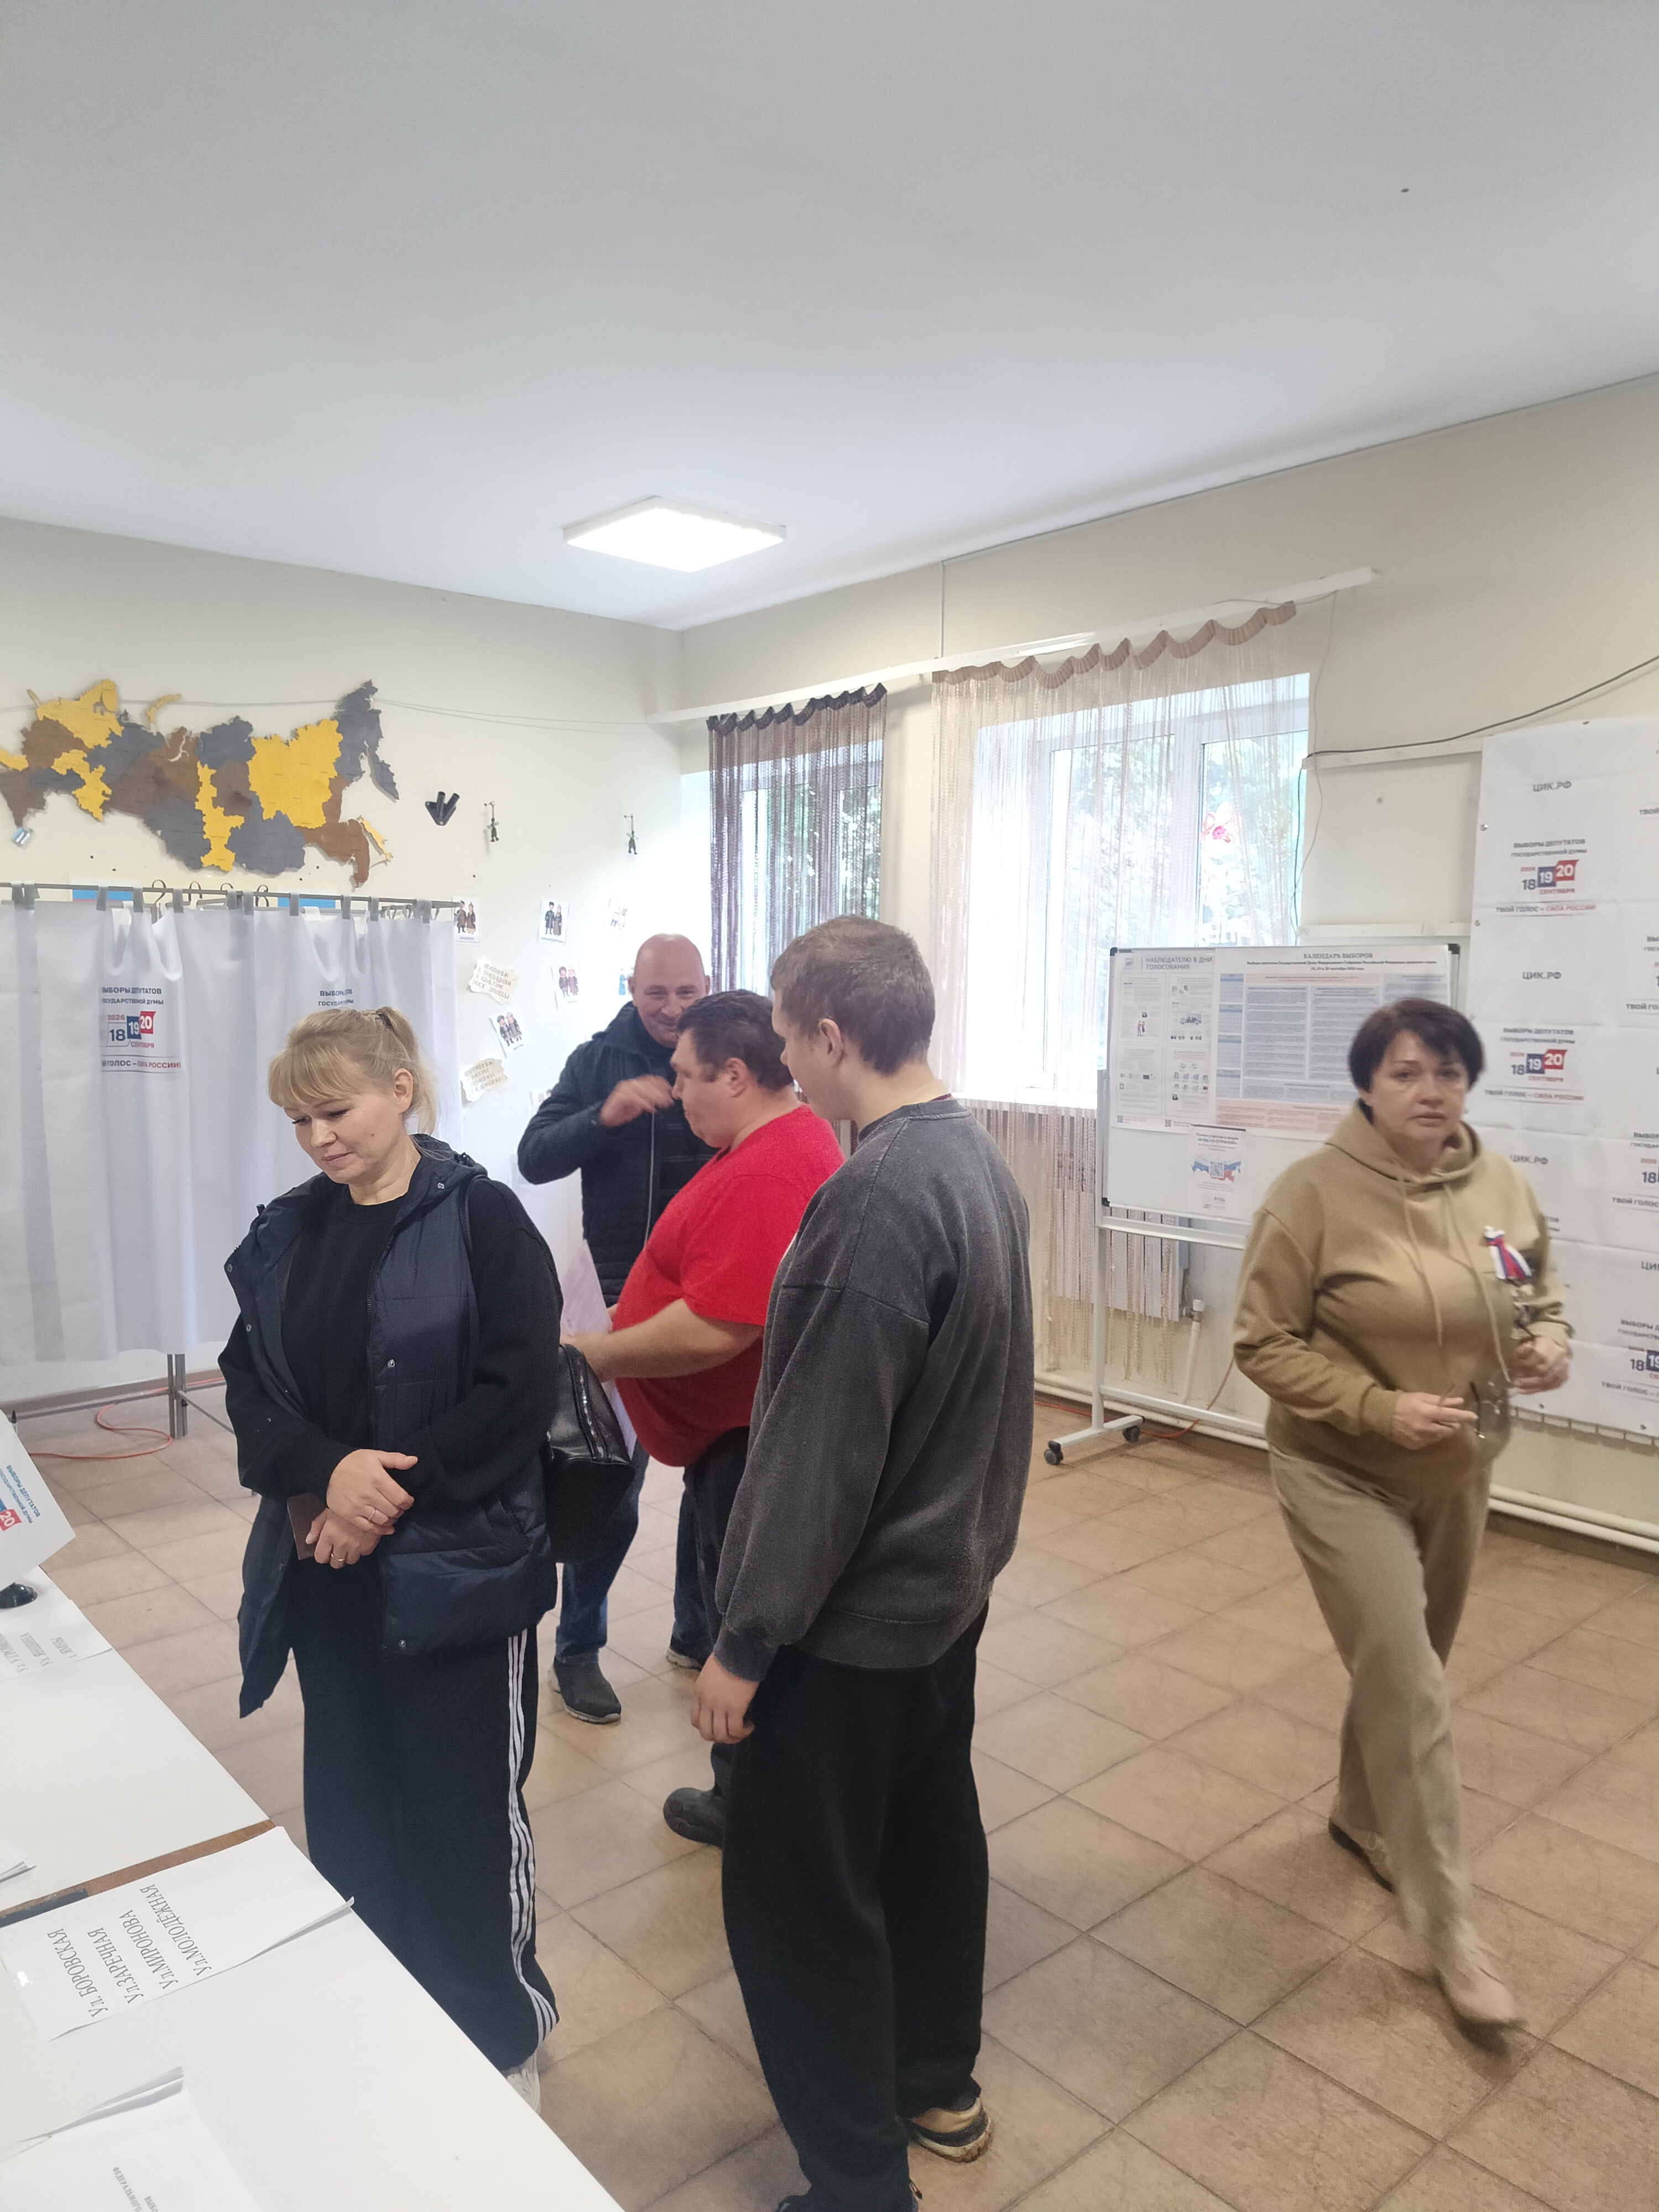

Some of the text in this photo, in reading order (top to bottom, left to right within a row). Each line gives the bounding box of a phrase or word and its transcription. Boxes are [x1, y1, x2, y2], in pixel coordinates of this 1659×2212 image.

[1532, 780, 1572, 792] ЦИК.РФ
[1521, 865, 1574, 890] 18 19 20
[109, 1016, 152, 1041] 18 19 20
[1511, 1053, 1563, 1076] 18 19 20
[1509, 1154, 1548, 1165] ЦИК.РФ
[1641, 1171, 1657, 1184] 18
[1630, 1358, 1645, 1371] 18
[6, 1465, 41, 1517] ВЫБОРЫ ДЕПУТАТОВ
[0, 1510, 15, 1527] 20
[139, 1884, 212, 1976] Ул.МОЛОДЁЖНАЯ
[119, 1910, 179, 1990] Ул.МИРОНОВА
[47, 1928, 108, 2017] Ул. БОРОВСКАЯ
[87, 1927, 144, 2004] Ул.ЗАРЕЧНАЯ
[113, 2167, 142, 2212] ФЕДЕРАЛЬНОГО
[144, 2195, 158, 2212] ВЫБО
